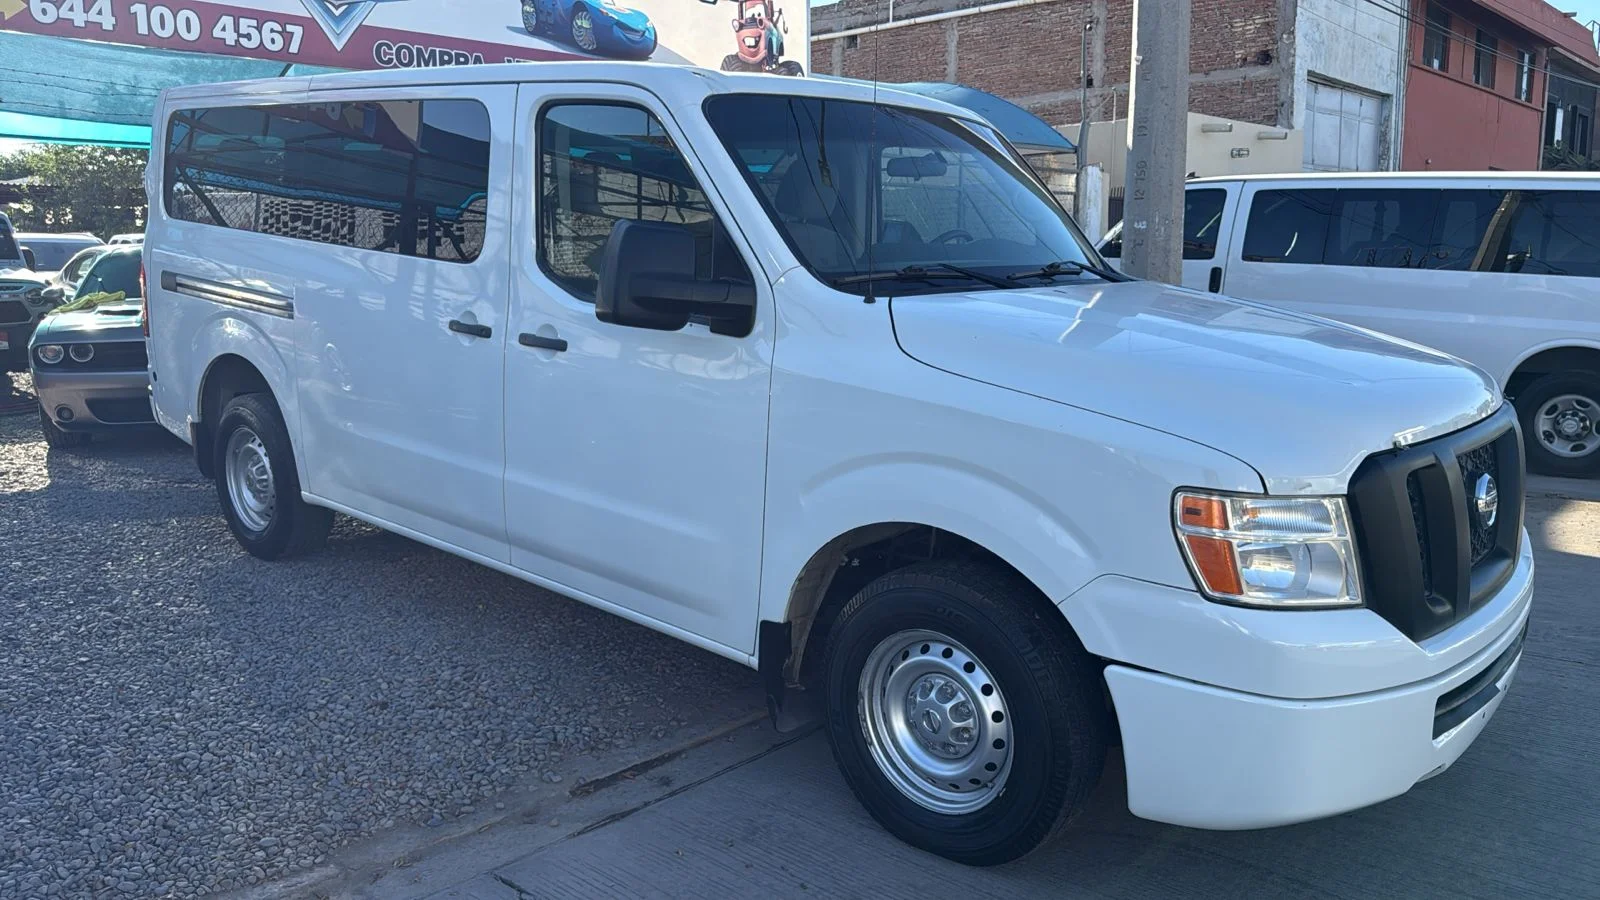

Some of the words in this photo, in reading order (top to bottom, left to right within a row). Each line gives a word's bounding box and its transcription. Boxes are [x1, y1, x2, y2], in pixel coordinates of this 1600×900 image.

[29, 0, 116, 31] 644
[130, 3, 201, 41] 100
[212, 15, 304, 54] 4567
